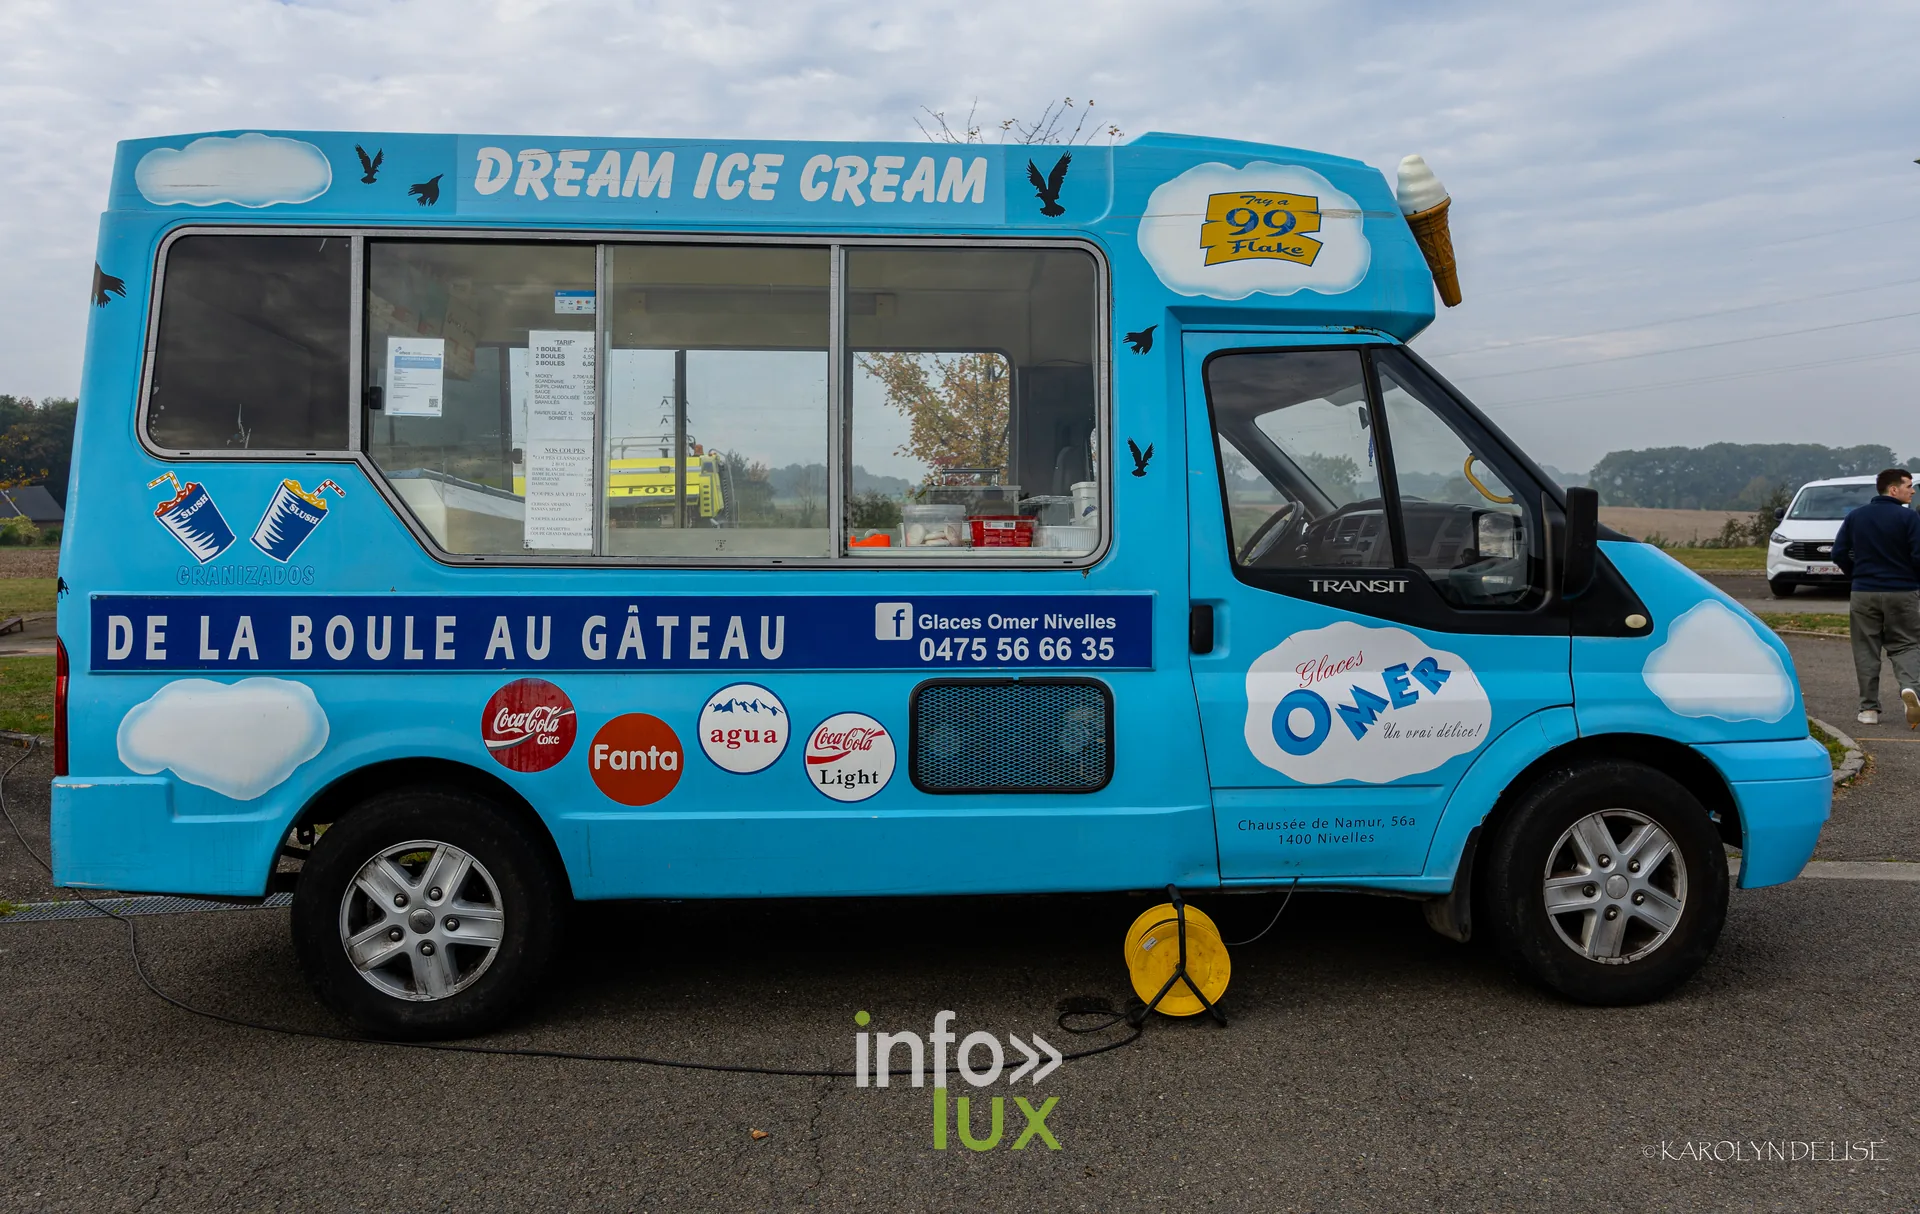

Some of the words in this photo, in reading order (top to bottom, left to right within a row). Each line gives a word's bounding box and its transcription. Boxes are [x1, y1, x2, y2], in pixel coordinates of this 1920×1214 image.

[473, 146, 675, 200] DREAM
[693, 152, 784, 200] ICE
[800, 154, 988, 206] CREAM
[1240, 195, 1273, 206] Try
[1226, 208, 1296, 237] 99
[1227, 237, 1305, 257] Flake
[180, 493, 210, 519] SLUSH
[288, 503, 320, 525] SLUSH
[176, 565, 315, 586] GRANIZADOS
[1309, 579, 1409, 593] TRANSIT
[107, 615, 168, 660] DE
[199, 615, 259, 660] LA
[290, 615, 457, 660] BOULE
[484, 615, 551, 660] AU
[581, 605, 785, 660] GÂTEAU
[918, 613, 982, 630] Glaces
[987, 614, 1038, 629] Omer
[1044, 614, 1116, 629] Nivelles
[919, 637, 987, 661] 0475
[996, 637, 1029, 661] 56
[1039, 637, 1072, 661] 66
[1081, 637, 1115, 661] 35
[1295, 650, 1364, 688] Glaces
[1271, 656, 1451, 756] OMER
[493, 706, 562, 734] Coca-Cola
[1383, 722, 1401, 740] Un
[1406, 725, 1433, 738] vrai
[1436, 721, 1482, 738] délice!
[537, 733, 560, 745] Coke
[710, 728, 778, 750] agua
[813, 726, 875, 751] Coca-Cola
[594, 744, 678, 771] Fanta
[820, 769, 879, 789] Light
[1237, 818, 1306, 831] Chaussée
[1311, 817, 1329, 829] de
[1334, 816, 1385, 829] Namur,
[1391, 816, 1416, 827] 56a
[1278, 834, 1312, 845] 1400
[1317, 832, 1375, 844] Nivelles
